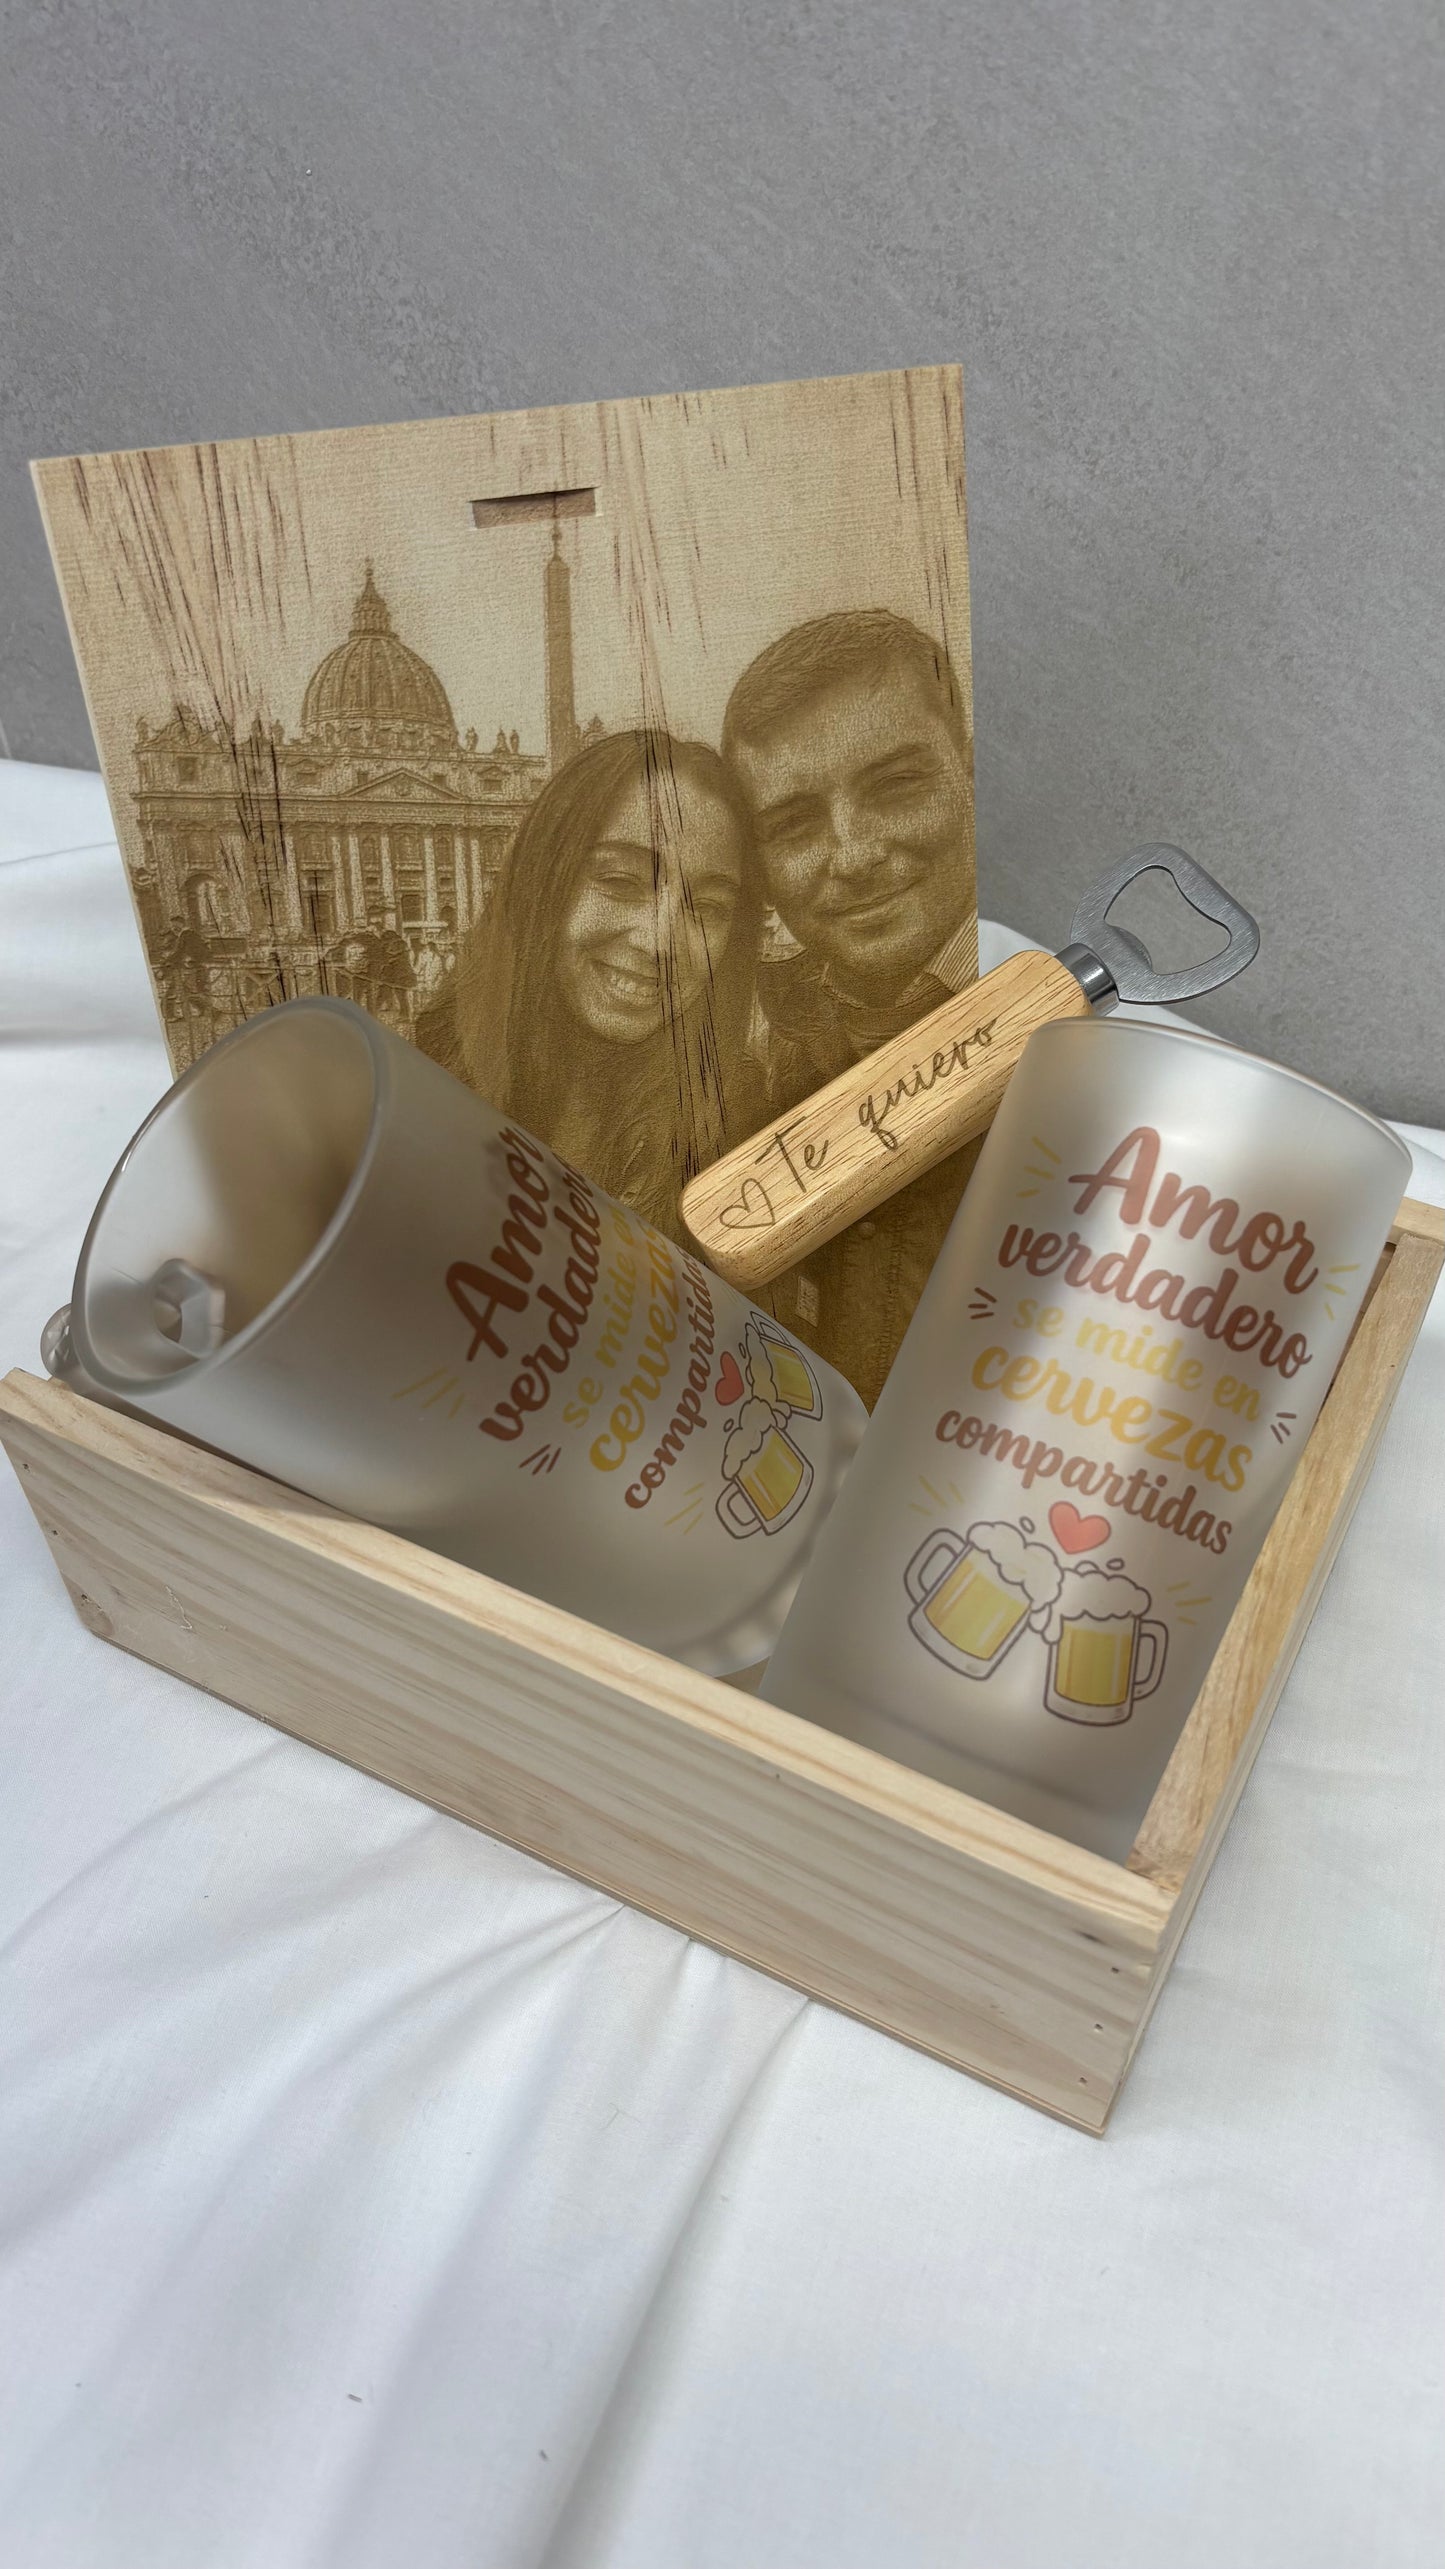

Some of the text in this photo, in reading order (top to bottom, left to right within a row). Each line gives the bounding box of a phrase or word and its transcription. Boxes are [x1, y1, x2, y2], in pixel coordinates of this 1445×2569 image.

[755, 1017, 998, 1194] Te quiero
[446, 1127, 549, 1361] Amor
[1068, 1126, 1319, 1295] Amor
[563, 1376, 603, 1428] se
[594, 1253, 638, 1368] mide
[997, 1223, 1312, 1379] verdadero
[1012, 1298, 1262, 1423] se mide en
[935, 1409, 1232, 1555] compartidas
[971, 1346, 1253, 1492] cervezas
